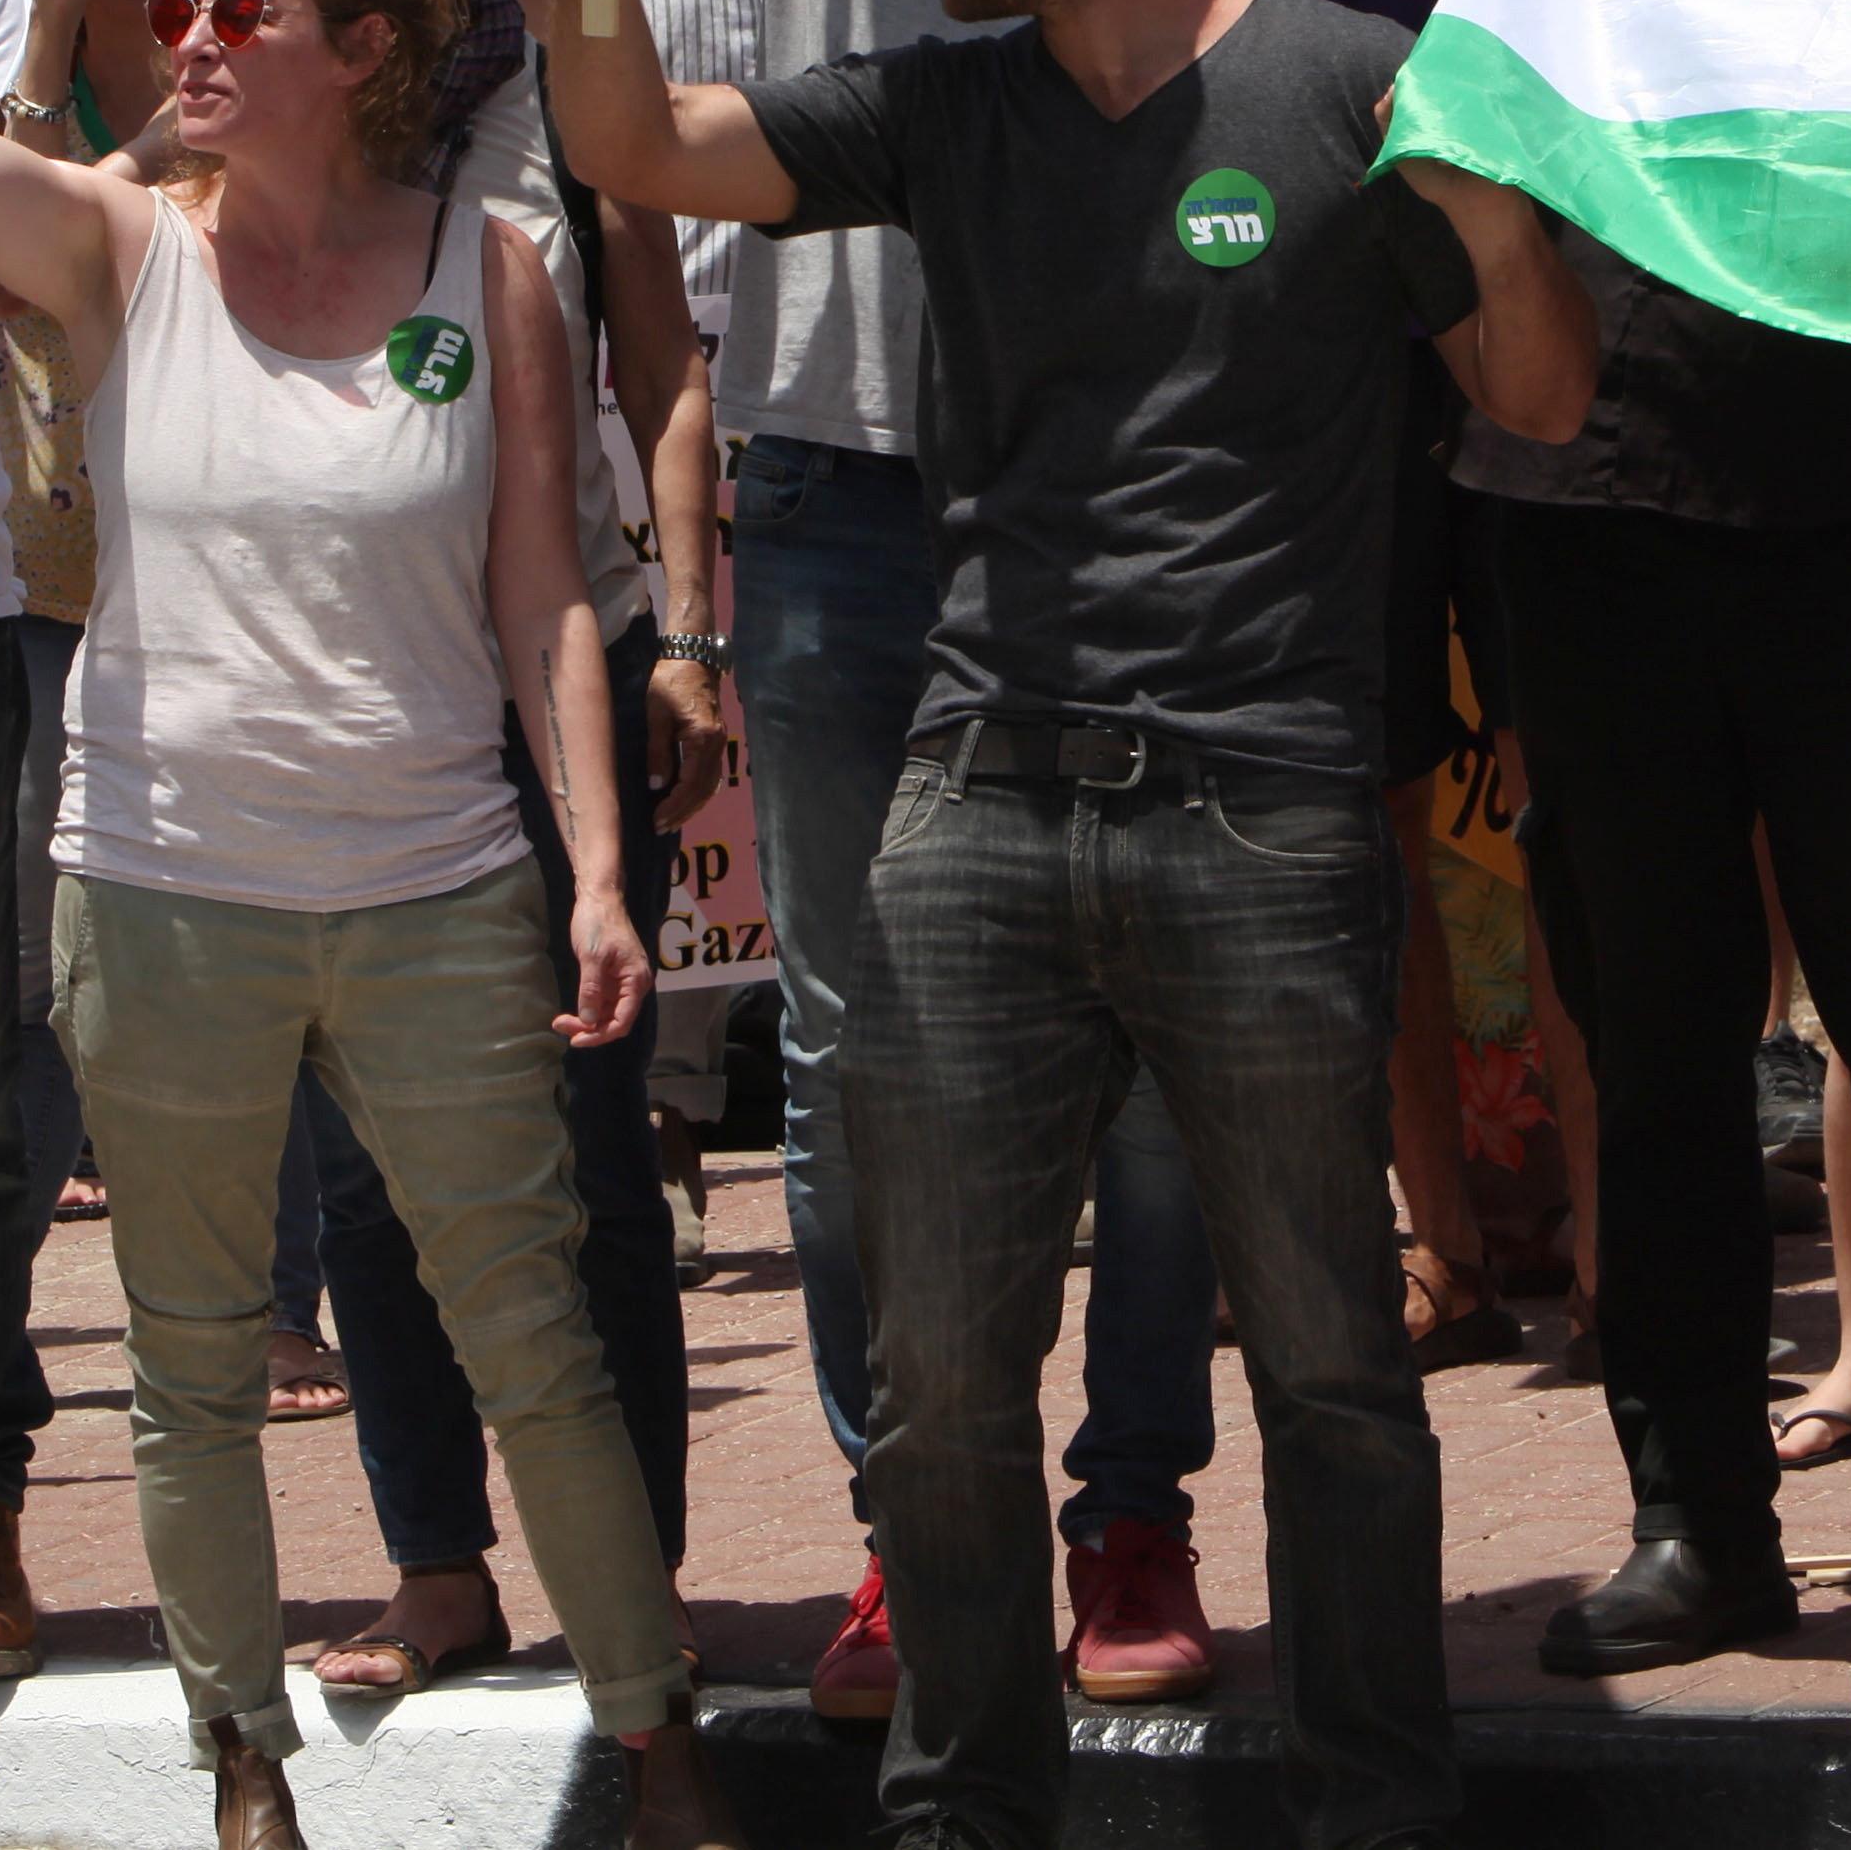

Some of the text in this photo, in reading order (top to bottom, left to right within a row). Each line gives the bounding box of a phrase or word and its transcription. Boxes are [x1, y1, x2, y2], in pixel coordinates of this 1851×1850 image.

[1187, 214, 1264, 245] מרצ
[415, 329, 465, 395] מרצ
[657, 912, 776, 972] Gaz
